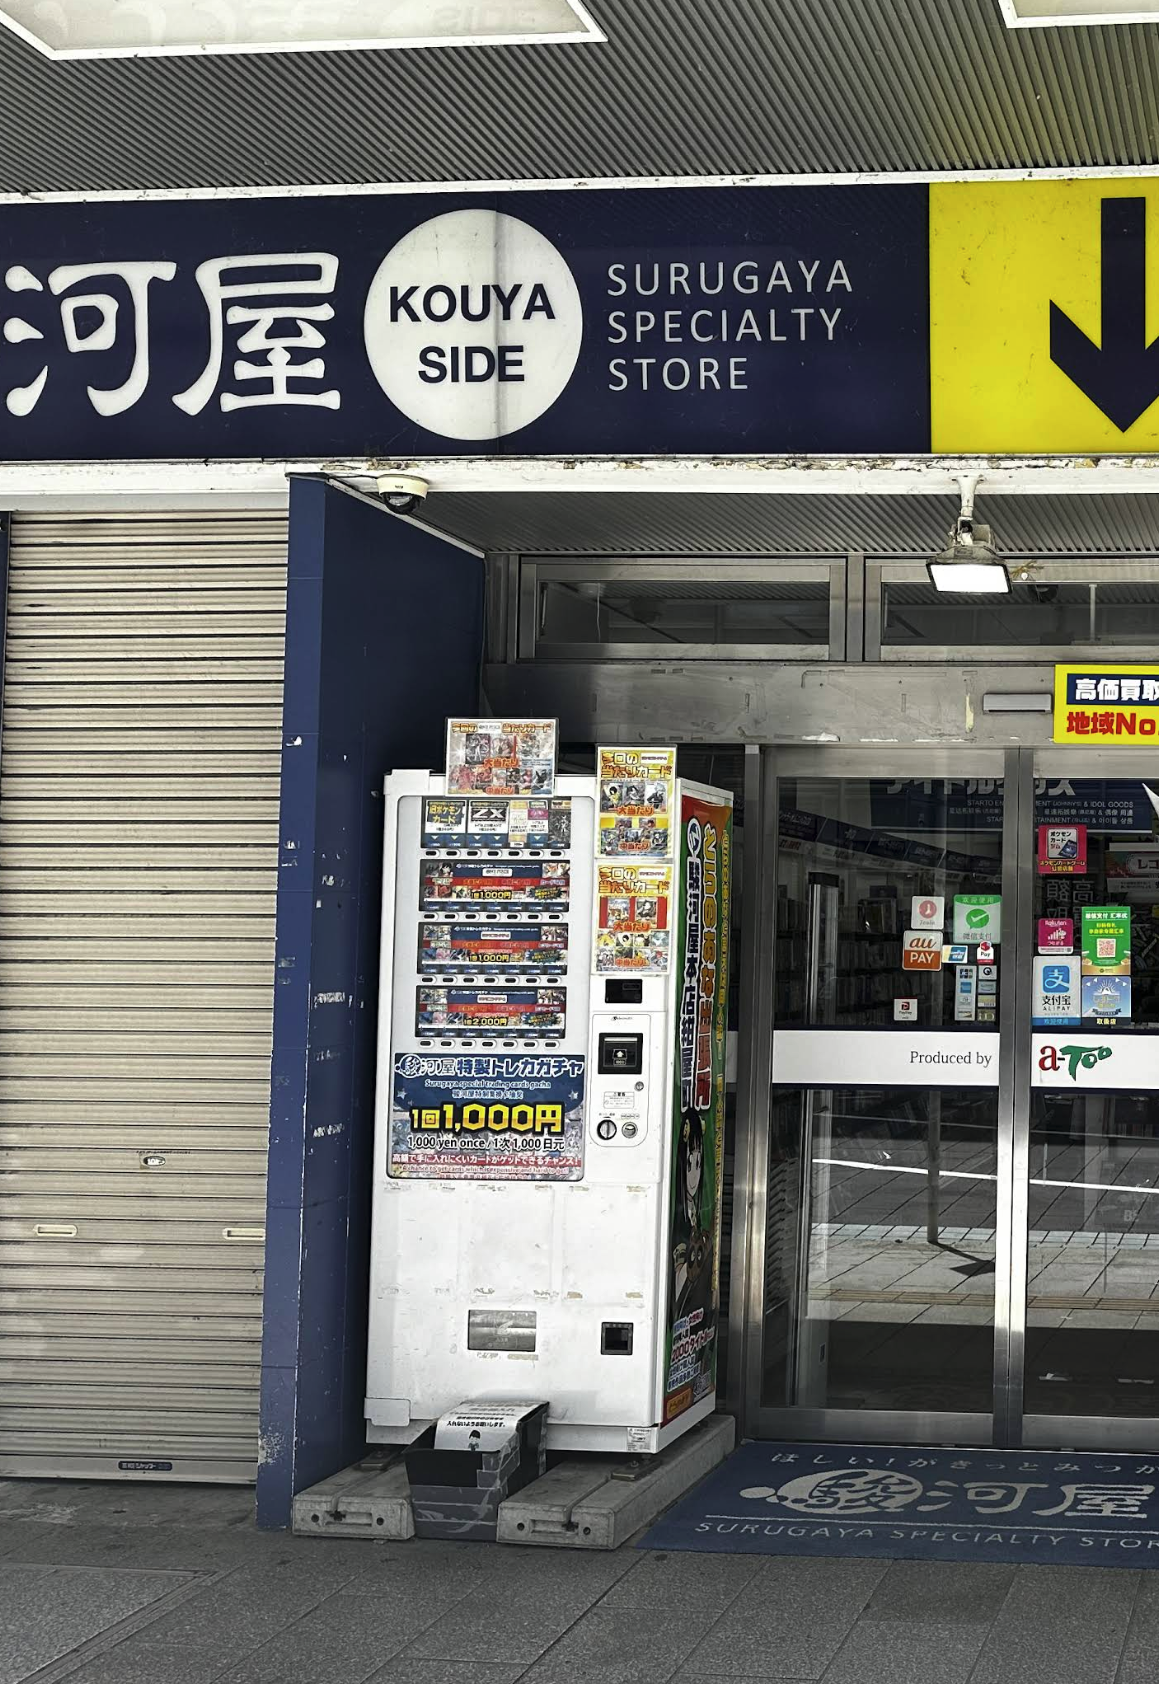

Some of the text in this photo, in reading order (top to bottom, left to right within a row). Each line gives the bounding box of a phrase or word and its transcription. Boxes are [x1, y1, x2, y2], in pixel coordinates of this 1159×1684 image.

[607, 258, 853, 297] SURUGAYA
[389, 283, 557, 323] KOUYA
[4, 253, 341, 416] 河屋
[607, 307, 843, 344] SPECIALTY
[418, 345, 525, 383] SIDE
[607, 356, 749, 391] STORE
[601, 752, 639, 764] 今回の
[601, 765, 672, 778] 当たりカード
[909, 937, 937, 948] au
[910, 952, 935, 963] PAY
[457, 1057, 583, 1078] 特製トレカガチャ
[910, 1051, 992, 1068] Produced by
[412, 1103, 562, 1133] 1回1,000円
[407, 1136, 435, 1149] 1,000
[437, 1139, 460, 1149] yen
[461, 1139, 485, 1148] once
[513, 1138, 540, 1149] 1,000
[543, 1139, 564, 1149] 日元
[739, 1468, 1155, 1519] 駿河屋
[694, 1521, 874, 1539] SURUGAYA
[888, 1528, 1065, 1546] SPECIALTY
